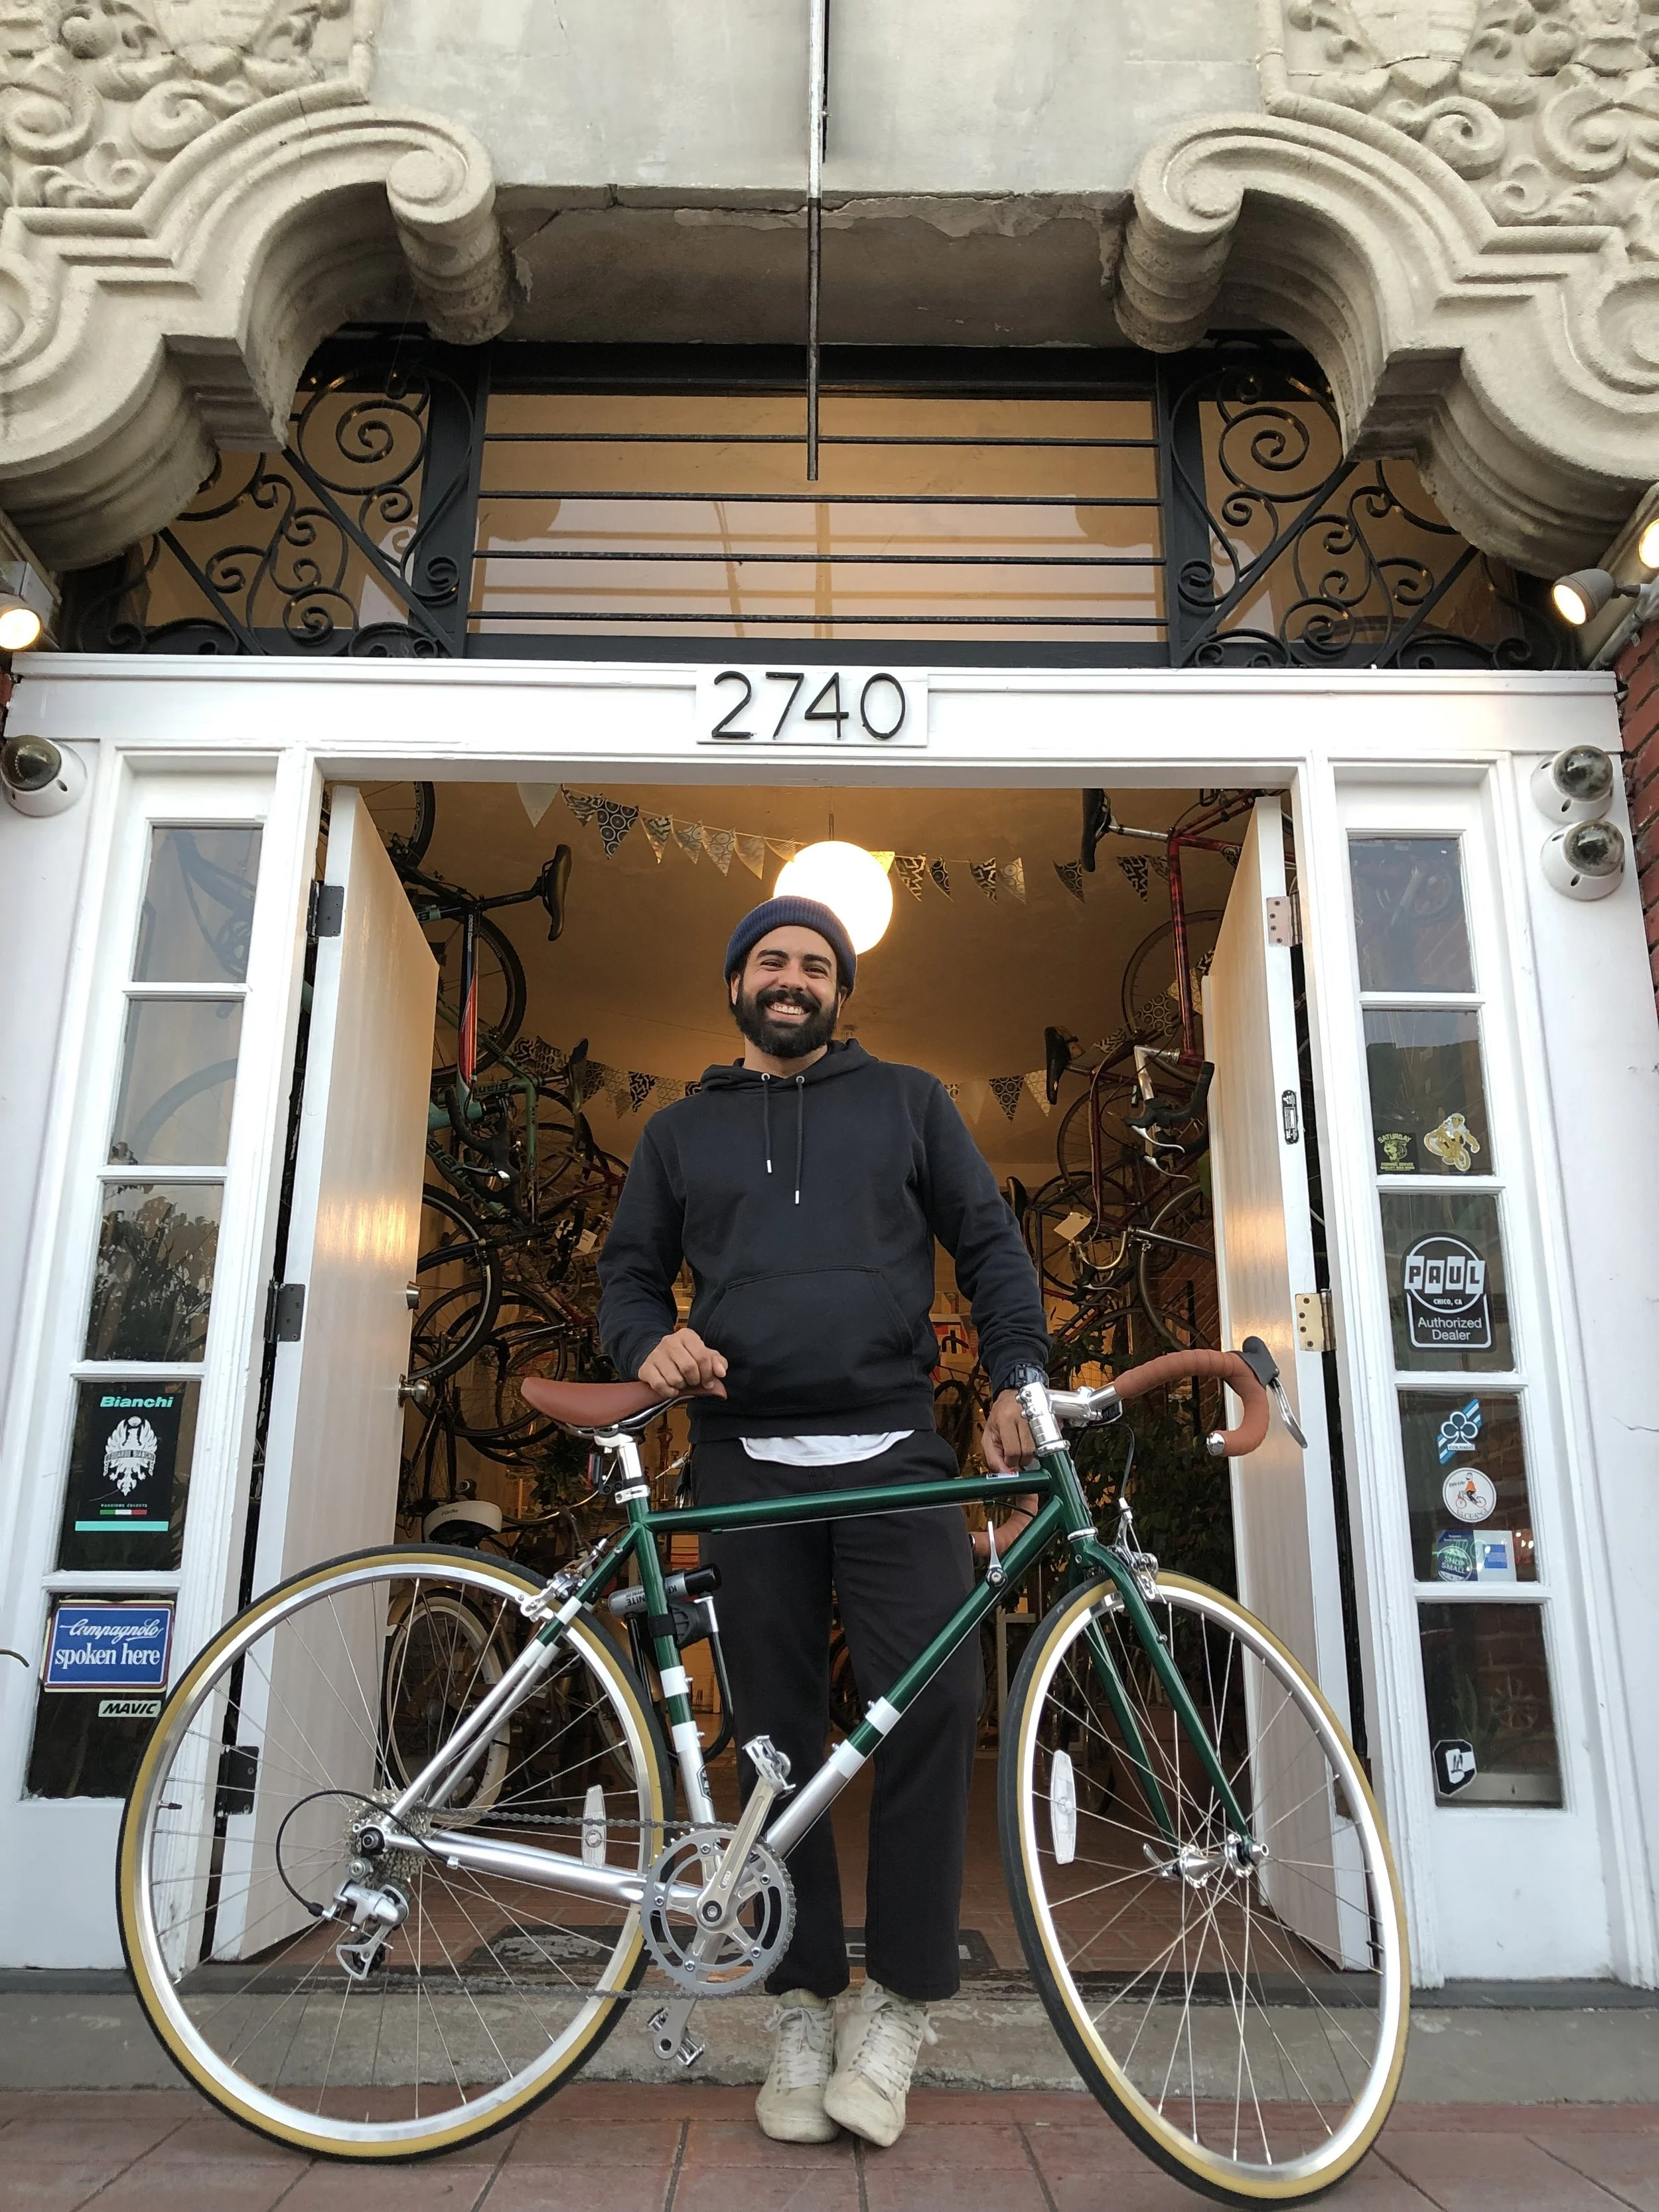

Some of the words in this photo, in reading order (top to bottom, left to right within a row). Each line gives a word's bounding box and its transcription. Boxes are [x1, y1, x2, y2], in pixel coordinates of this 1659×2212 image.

[711, 670, 905, 740] 2740
[1377, 1133, 1412, 1143] SATURDAY
[1408, 1265, 1481, 1284] PAUL
[1417, 1316, 1482, 1329] Authorized
[1432, 1329, 1471, 1341] Dealer
[100, 1396, 175, 1408] Bianchi
[1444, 1556, 1465, 1567] SHOP
[1441, 1562, 1466, 1574] SMALL
[60, 1619, 165, 1645] Campagnolo
[55, 1643, 115, 1669] spoken
[120, 1643, 161, 1665] here
[103, 1703, 157, 1714] MAVIC
